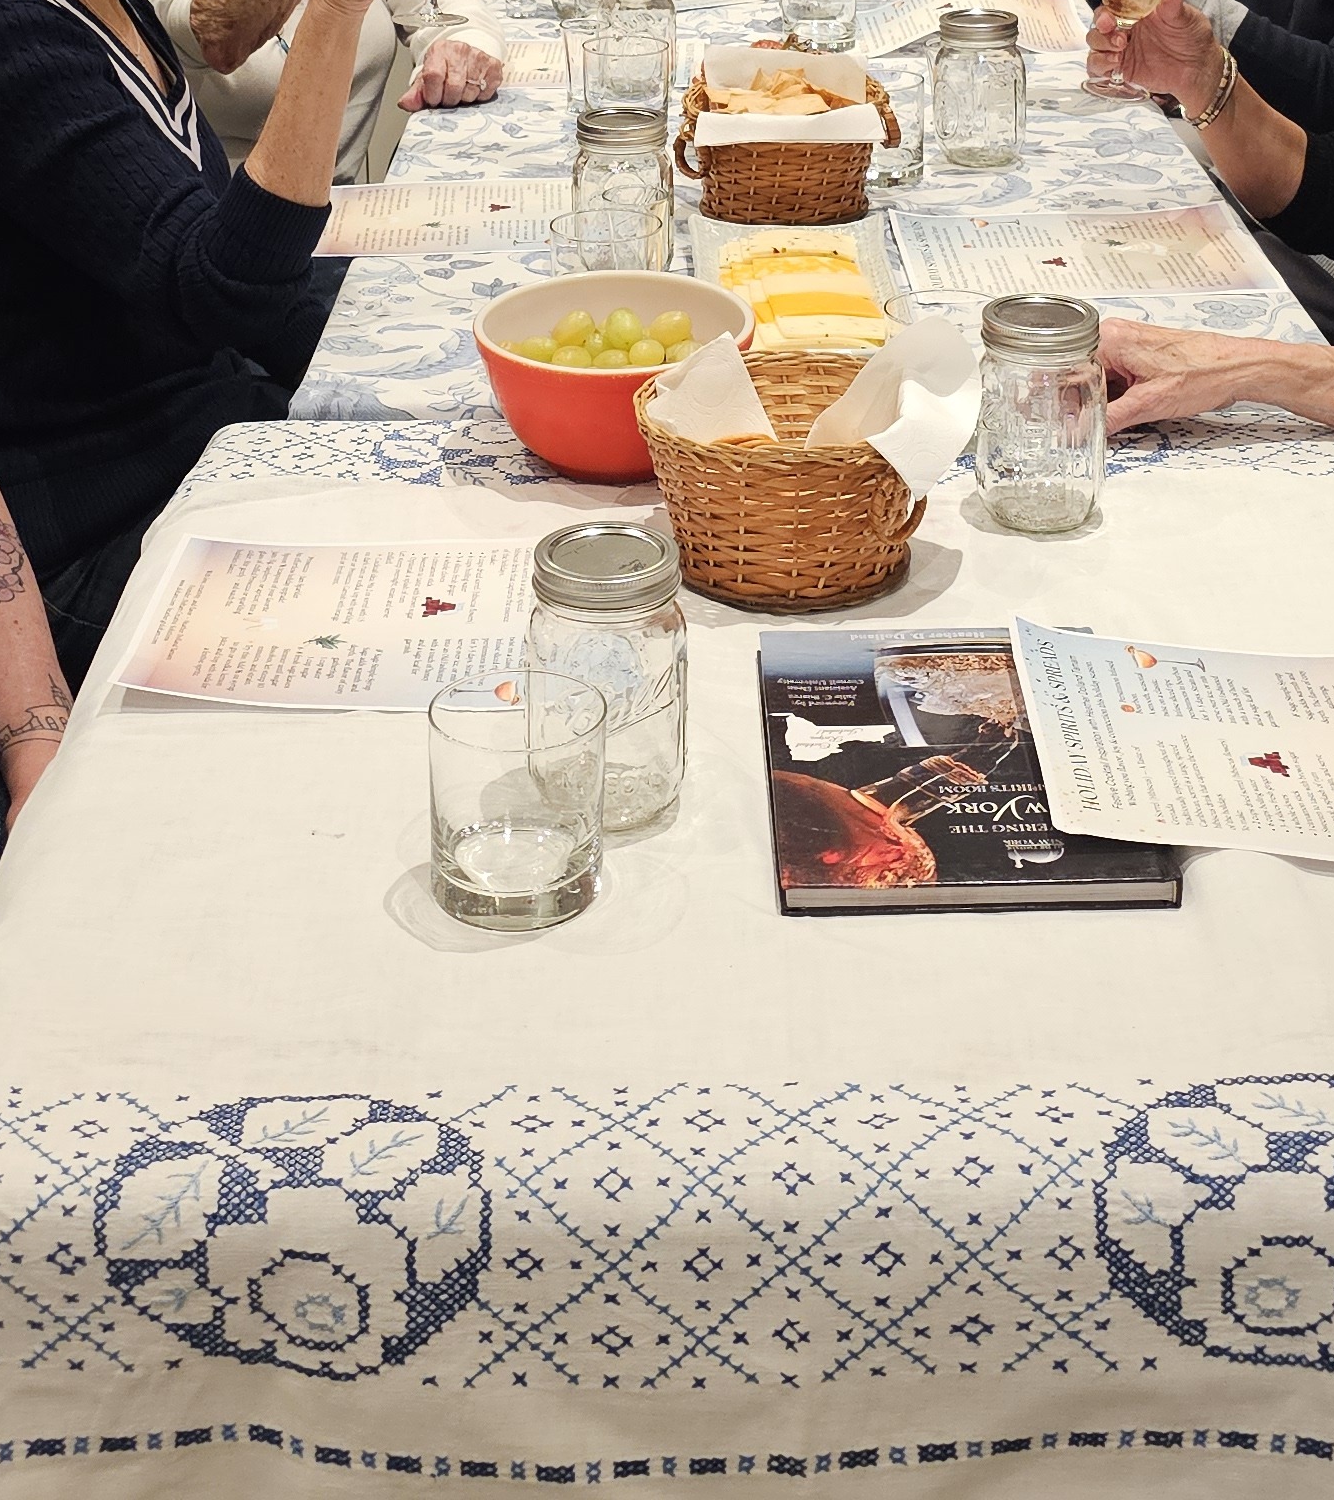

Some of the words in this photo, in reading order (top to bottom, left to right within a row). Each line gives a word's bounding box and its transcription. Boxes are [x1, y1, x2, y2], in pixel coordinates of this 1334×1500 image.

[929, 631, 985, 639] Heather
[1036, 639, 1067, 689] SPREADS
[1054, 706, 1084, 748] SPIRITS
[939, 785, 987, 794] BOOM
[1069, 754, 1101, 811] HOLIDAY
[944, 795, 1035, 821] YORK
[949, 825, 988, 833] THE
